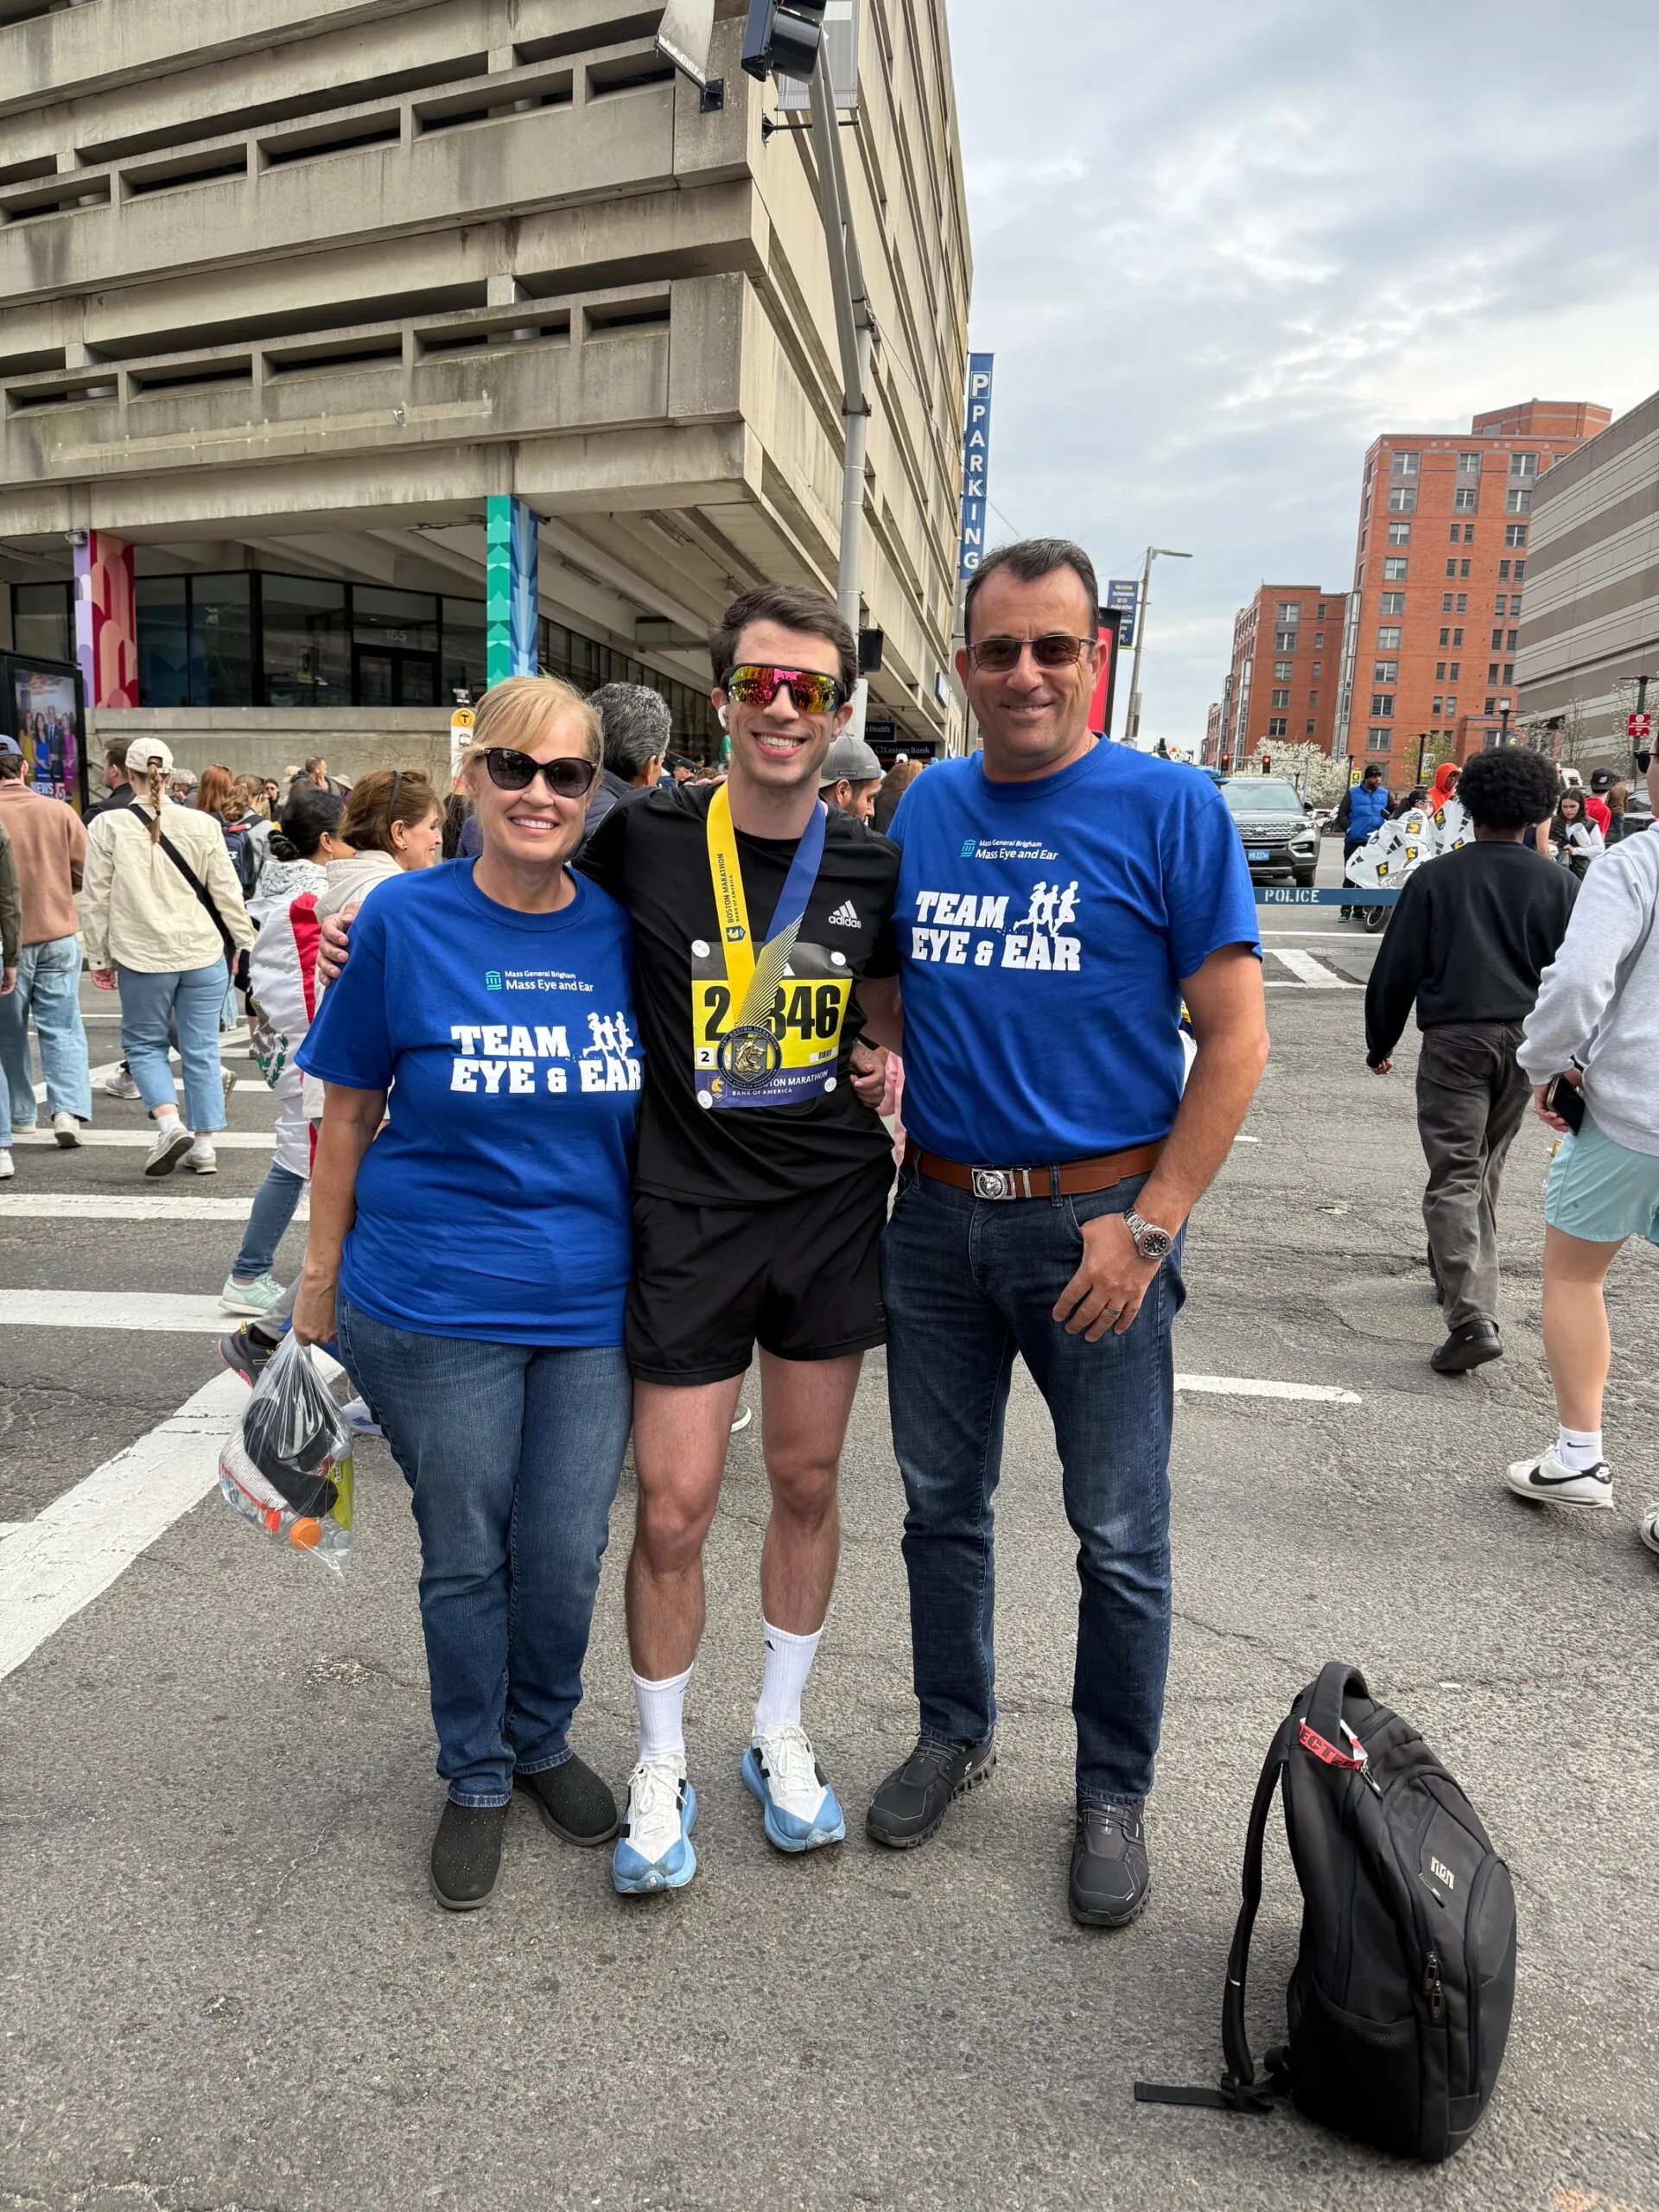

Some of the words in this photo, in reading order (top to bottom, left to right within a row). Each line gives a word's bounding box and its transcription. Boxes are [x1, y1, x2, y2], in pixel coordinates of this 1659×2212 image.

[971, 373, 989, 397] P
[963, 404, 987, 569] PARKING
[461, 714, 469, 724] T
[975, 849, 998, 860] Mass
[999, 848, 1017, 861] Eye
[1017, 849, 1039, 859] and
[1039, 849, 1059, 861] Ear
[1016, 840, 1043, 849] Brigham
[717, 853, 729, 893] MARATHON
[1264, 889, 1320, 903] POLICE
[724, 894, 734, 924] BOSTON
[915, 890, 1010, 929] TEAM
[828, 915, 862, 929] adidas
[912, 926, 970, 964] EYE
[974, 940, 995, 967] &
[1001, 934, 1082, 971] EAR
[550, 971, 576, 980] Brigham
[505, 979, 536, 991] Mass
[537, 979, 557, 992] Eye
[558, 981, 577, 991] and
[578, 982, 594, 993] Ear
[450, 1025, 571, 1058] TEAM
[753, 1027, 779, 1051] MARATHON
[701, 1051, 710, 1063] 2
[450, 1058, 536, 1094] EYE
[547, 1067, 568, 1093] &
[578, 1058, 641, 1093] EAR
[788, 1069, 829, 1086] MARATHON
